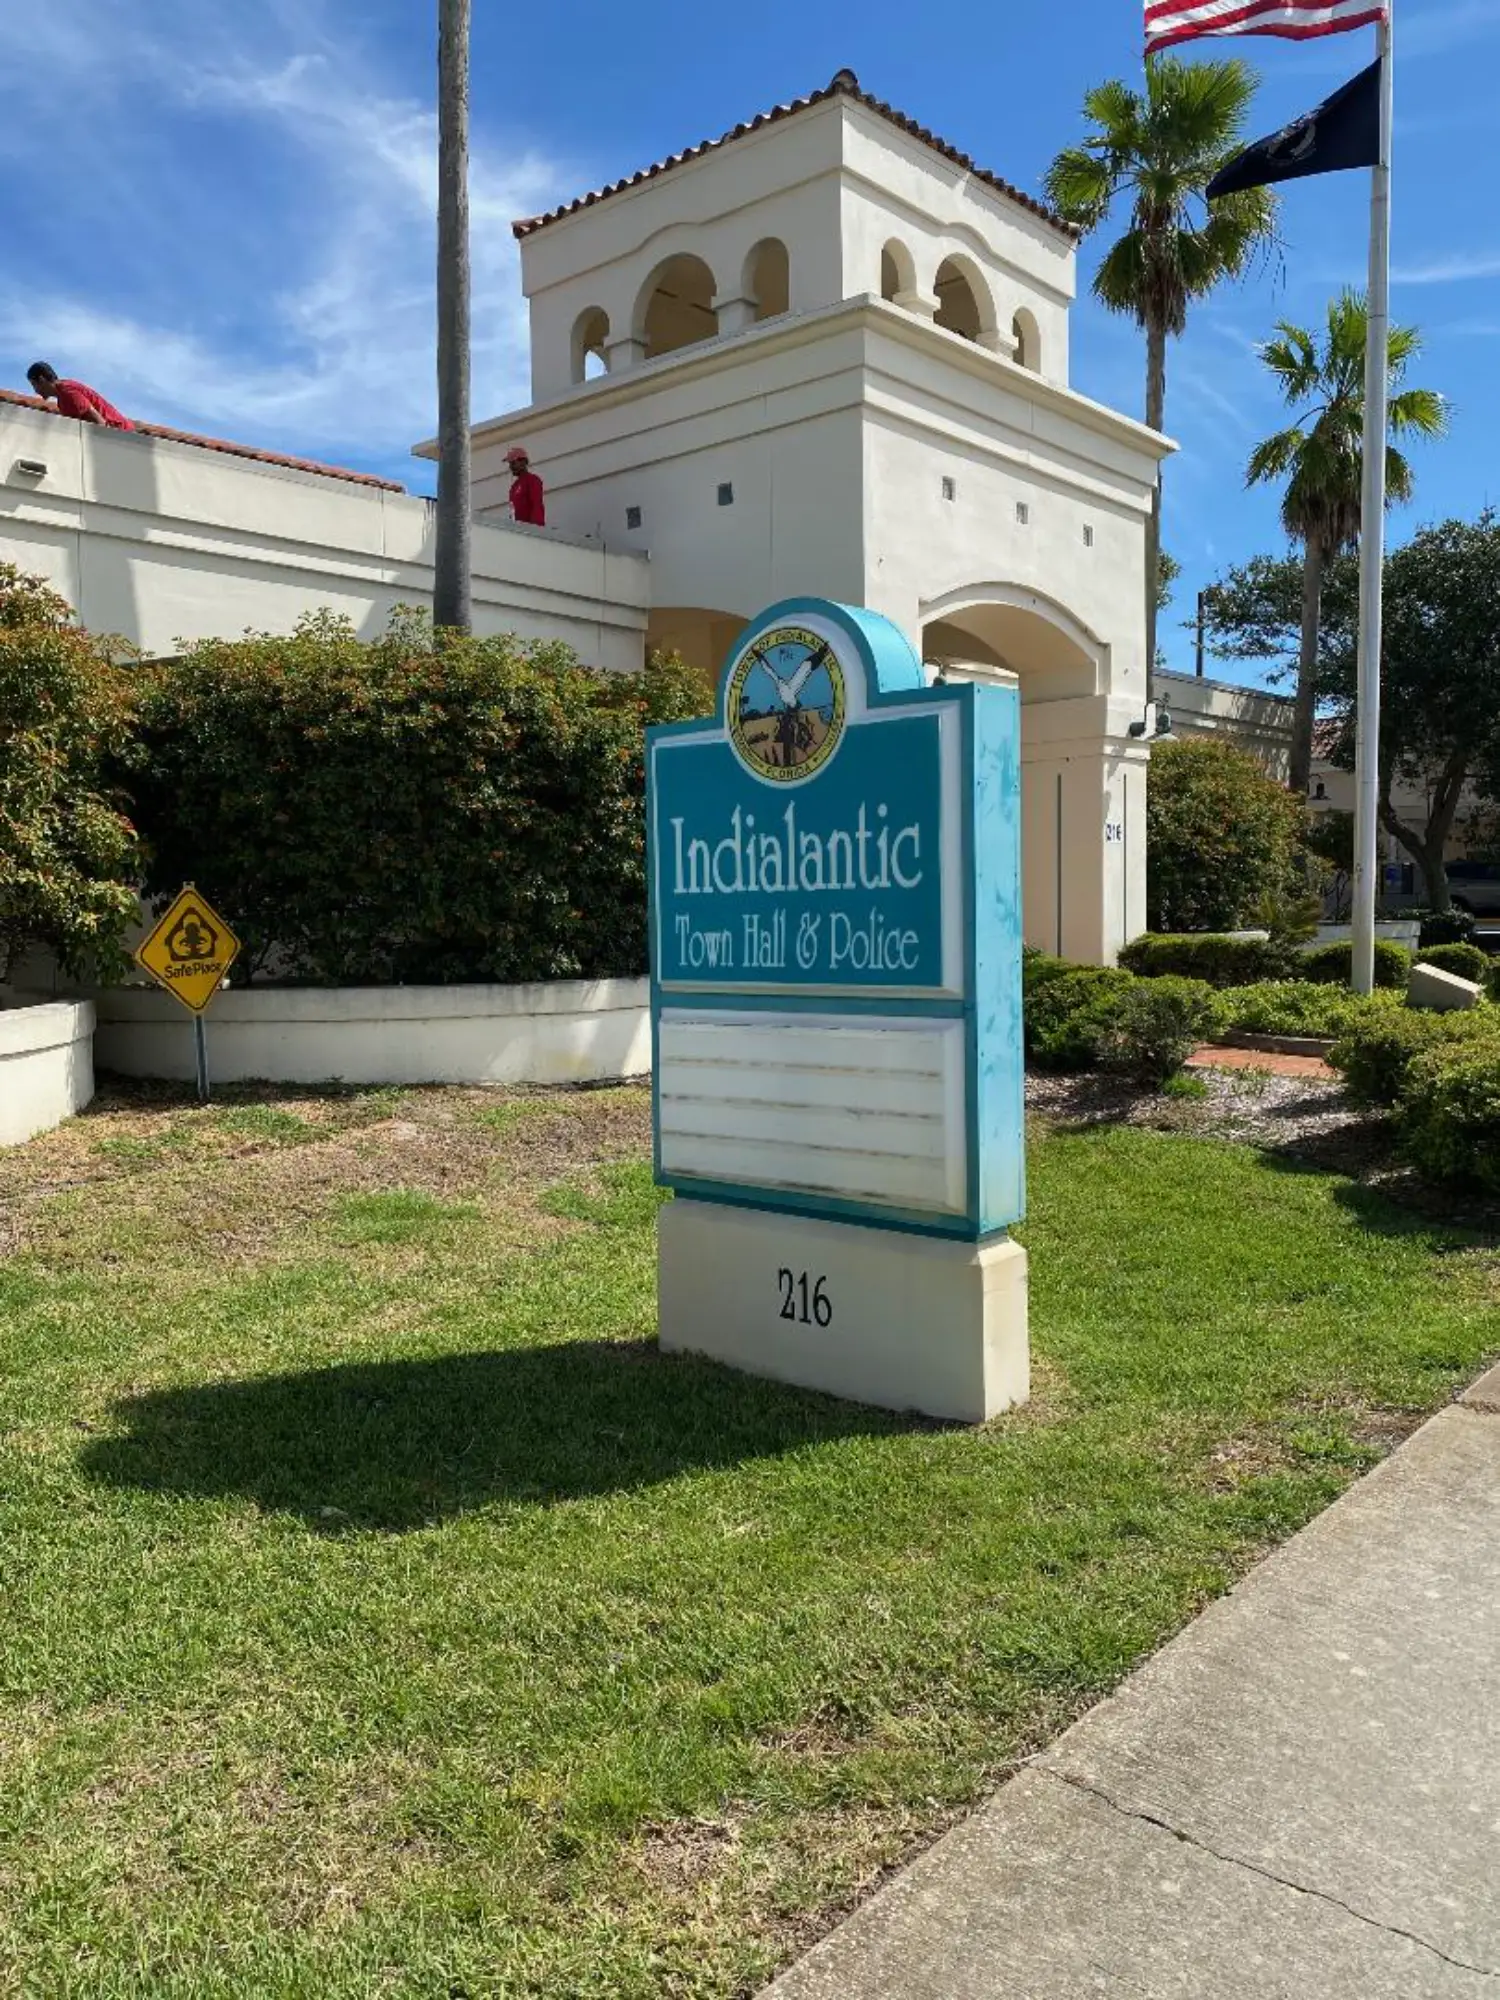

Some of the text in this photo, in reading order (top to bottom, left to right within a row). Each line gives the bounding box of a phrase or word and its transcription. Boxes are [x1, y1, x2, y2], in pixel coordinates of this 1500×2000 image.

[765, 763, 812, 779] FLORIDA
[670, 800, 923, 893] Indialantic
[1106, 823, 1121, 841] 216
[676, 906, 919, 969] Town Hall & Police
[779, 1267, 832, 1327] 216
